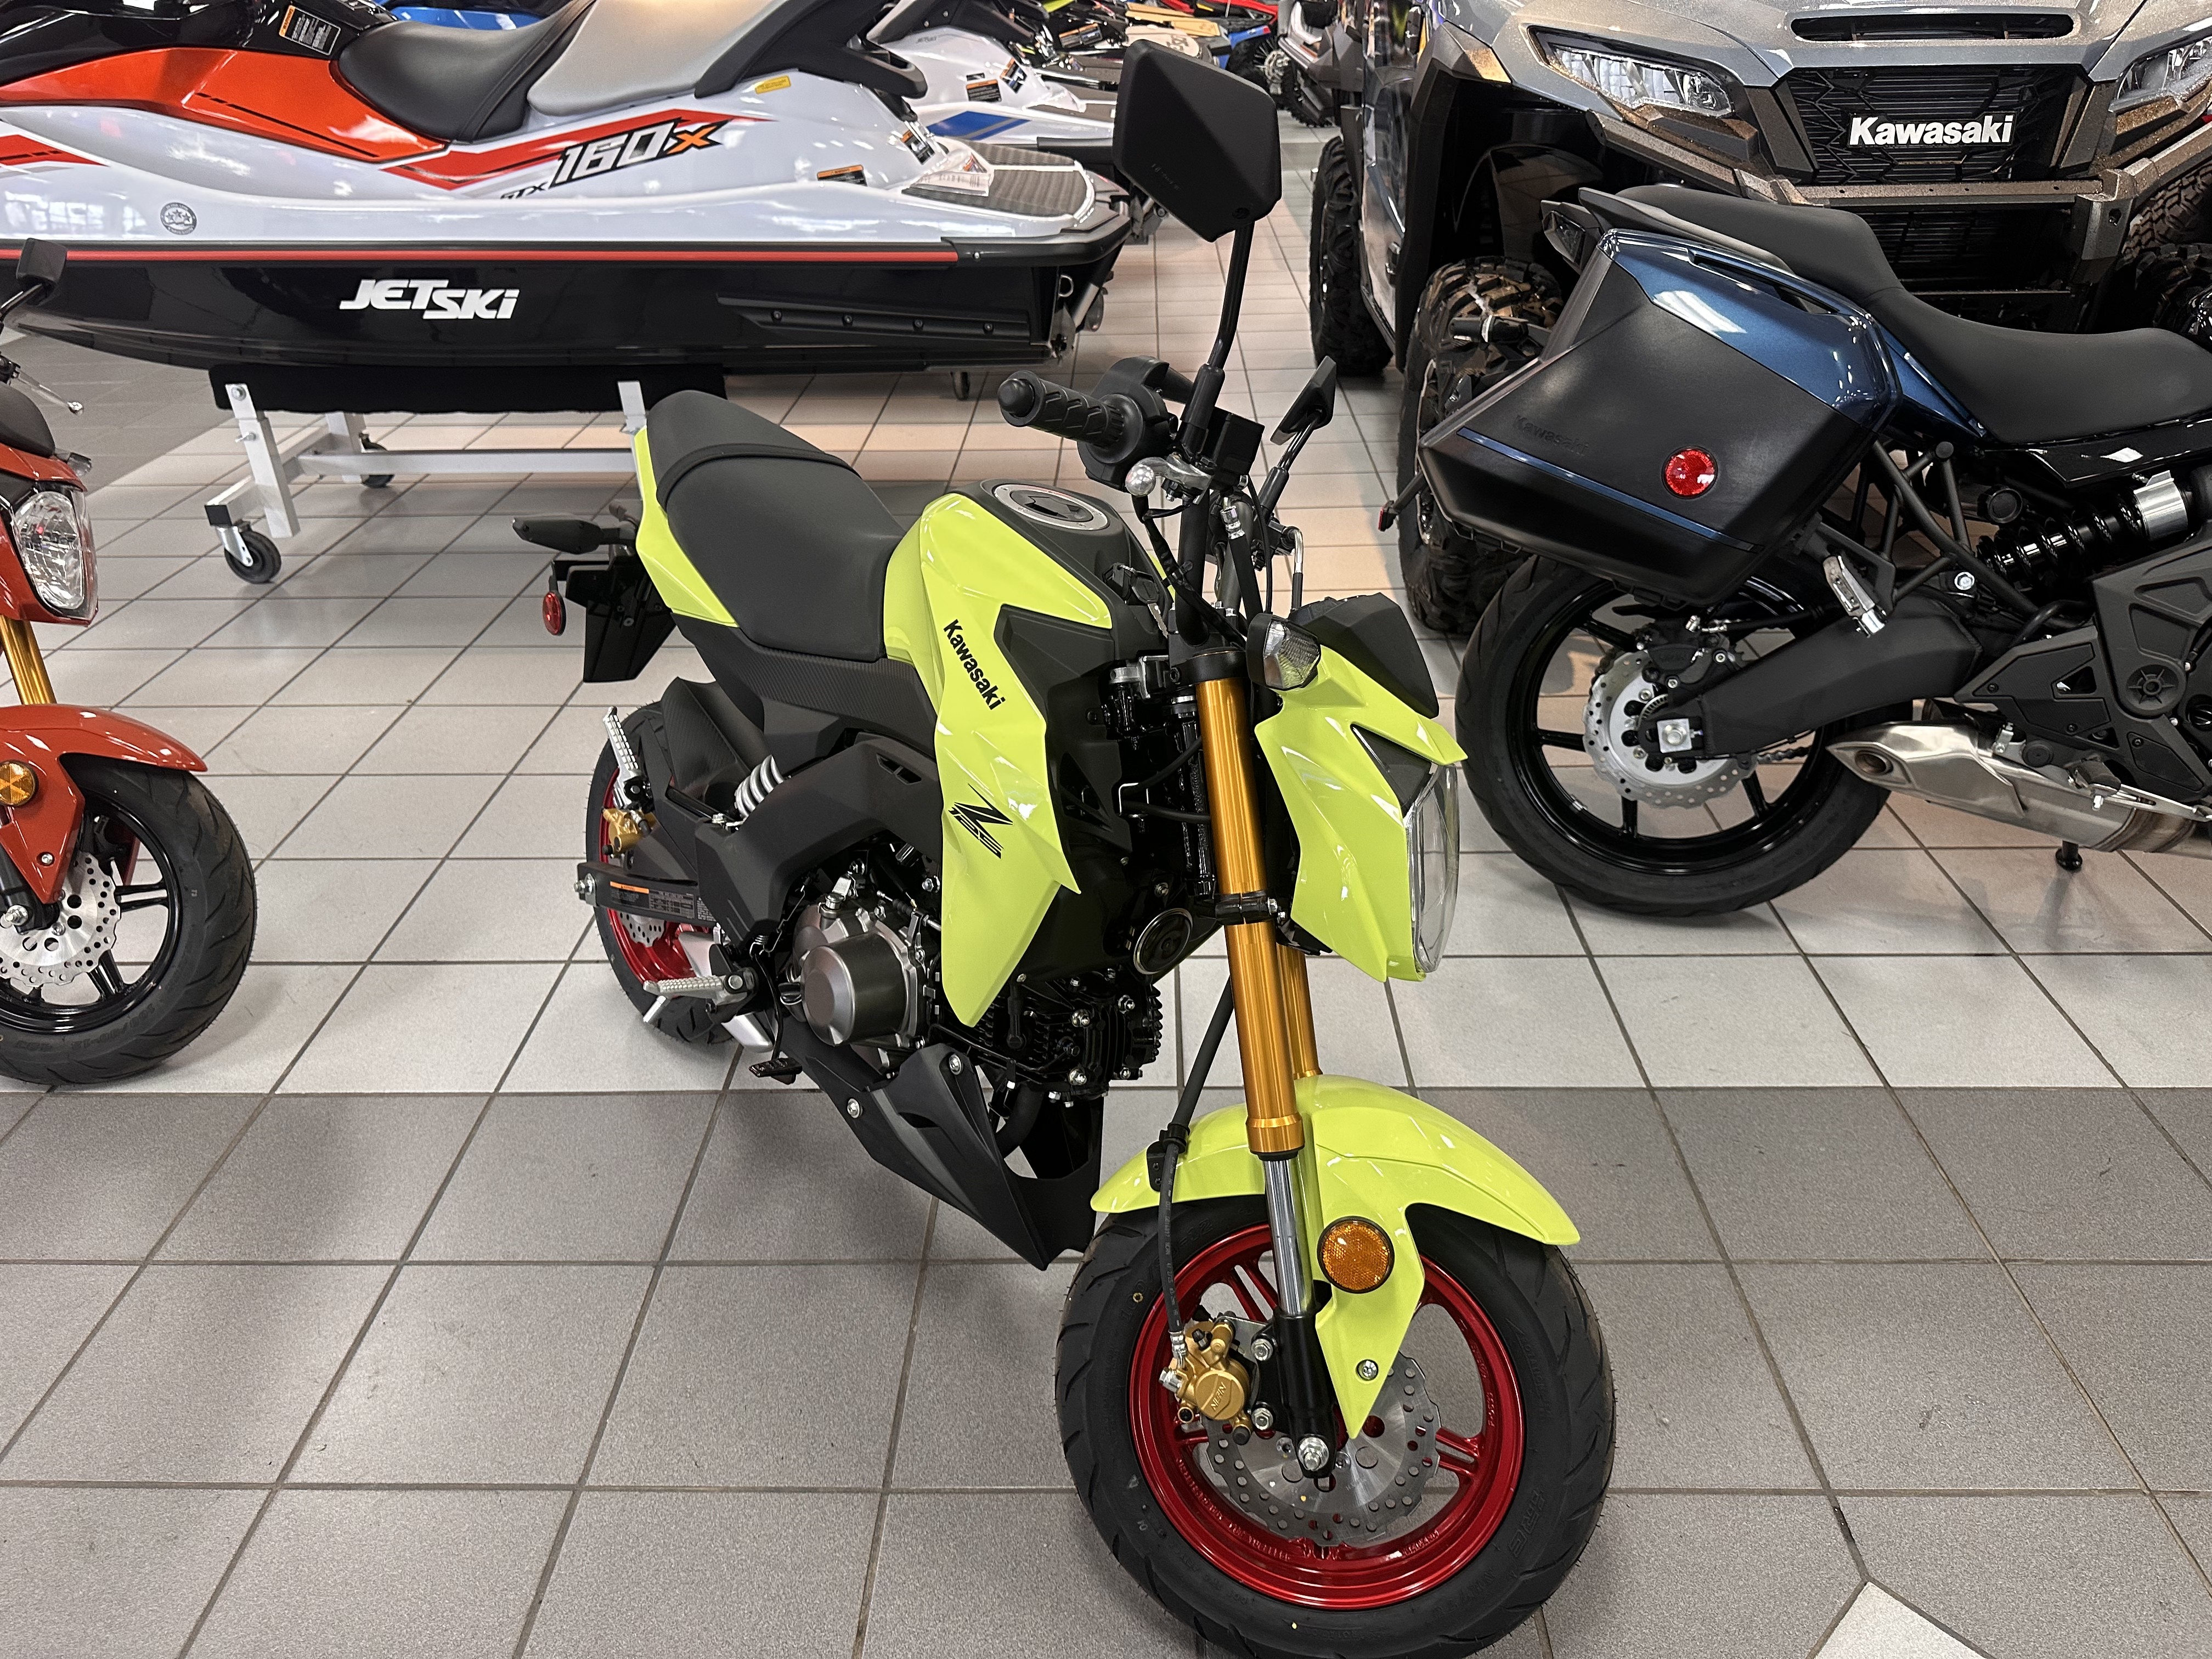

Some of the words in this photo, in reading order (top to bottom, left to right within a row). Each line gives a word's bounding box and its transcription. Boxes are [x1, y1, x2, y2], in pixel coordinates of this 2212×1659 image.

[1849, 115, 2014, 146] Kawasaki
[1514, 415, 1590, 457] Kawasaki
[943, 619, 1006, 710] Kawasaki
